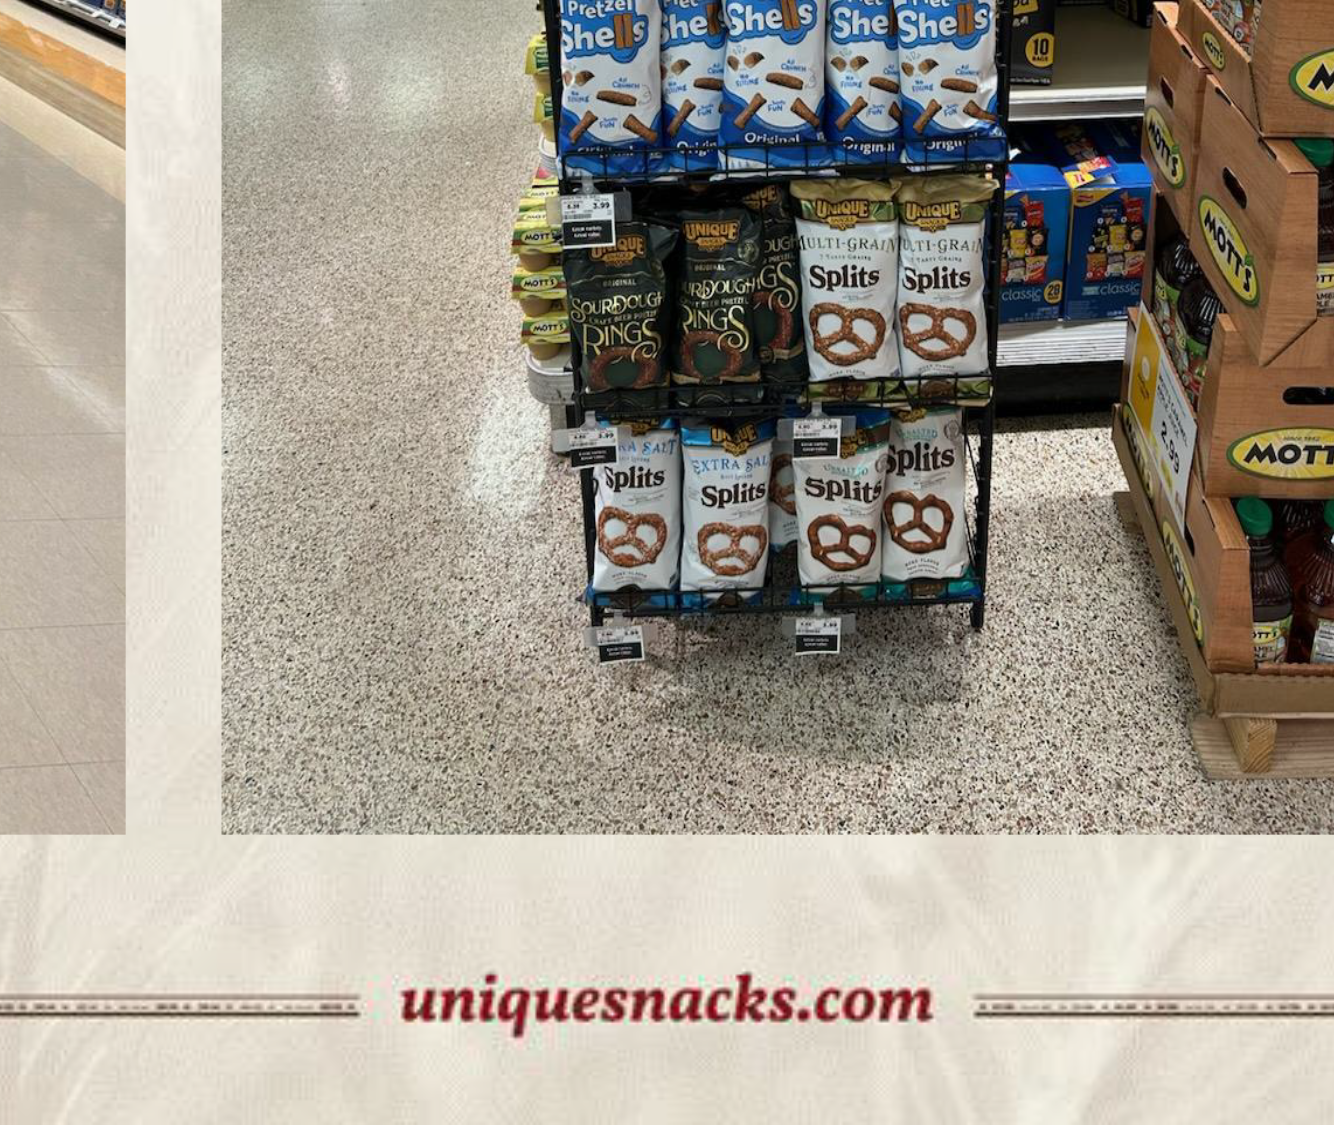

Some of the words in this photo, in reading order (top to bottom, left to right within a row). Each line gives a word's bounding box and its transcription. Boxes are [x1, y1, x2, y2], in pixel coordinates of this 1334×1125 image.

[561, 13, 645, 53] Shells
[897, 1, 989, 45] Shells
[1031, 37, 1049, 56] 10
[744, 132, 800, 145] Original
[816, 199, 869, 218] UNIQUE
[906, 201, 961, 221] UNIQUE
[684, 221, 740, 240] UNIQUE
[1203, 208, 1253, 293] MOTT'S
[810, 265, 880, 292] Splits
[903, 267, 971, 294] Splits
[1100, 283, 1140, 295] classic
[571, 292, 663, 323] SOURDOUGH
[1002, 288, 1042, 301] classic
[583, 318, 662, 362] RINGS
[642, 439, 677, 456] SALT
[605, 466, 665, 493] Splits
[806, 476, 882, 503] Splits
[701, 483, 766, 509] Splits
